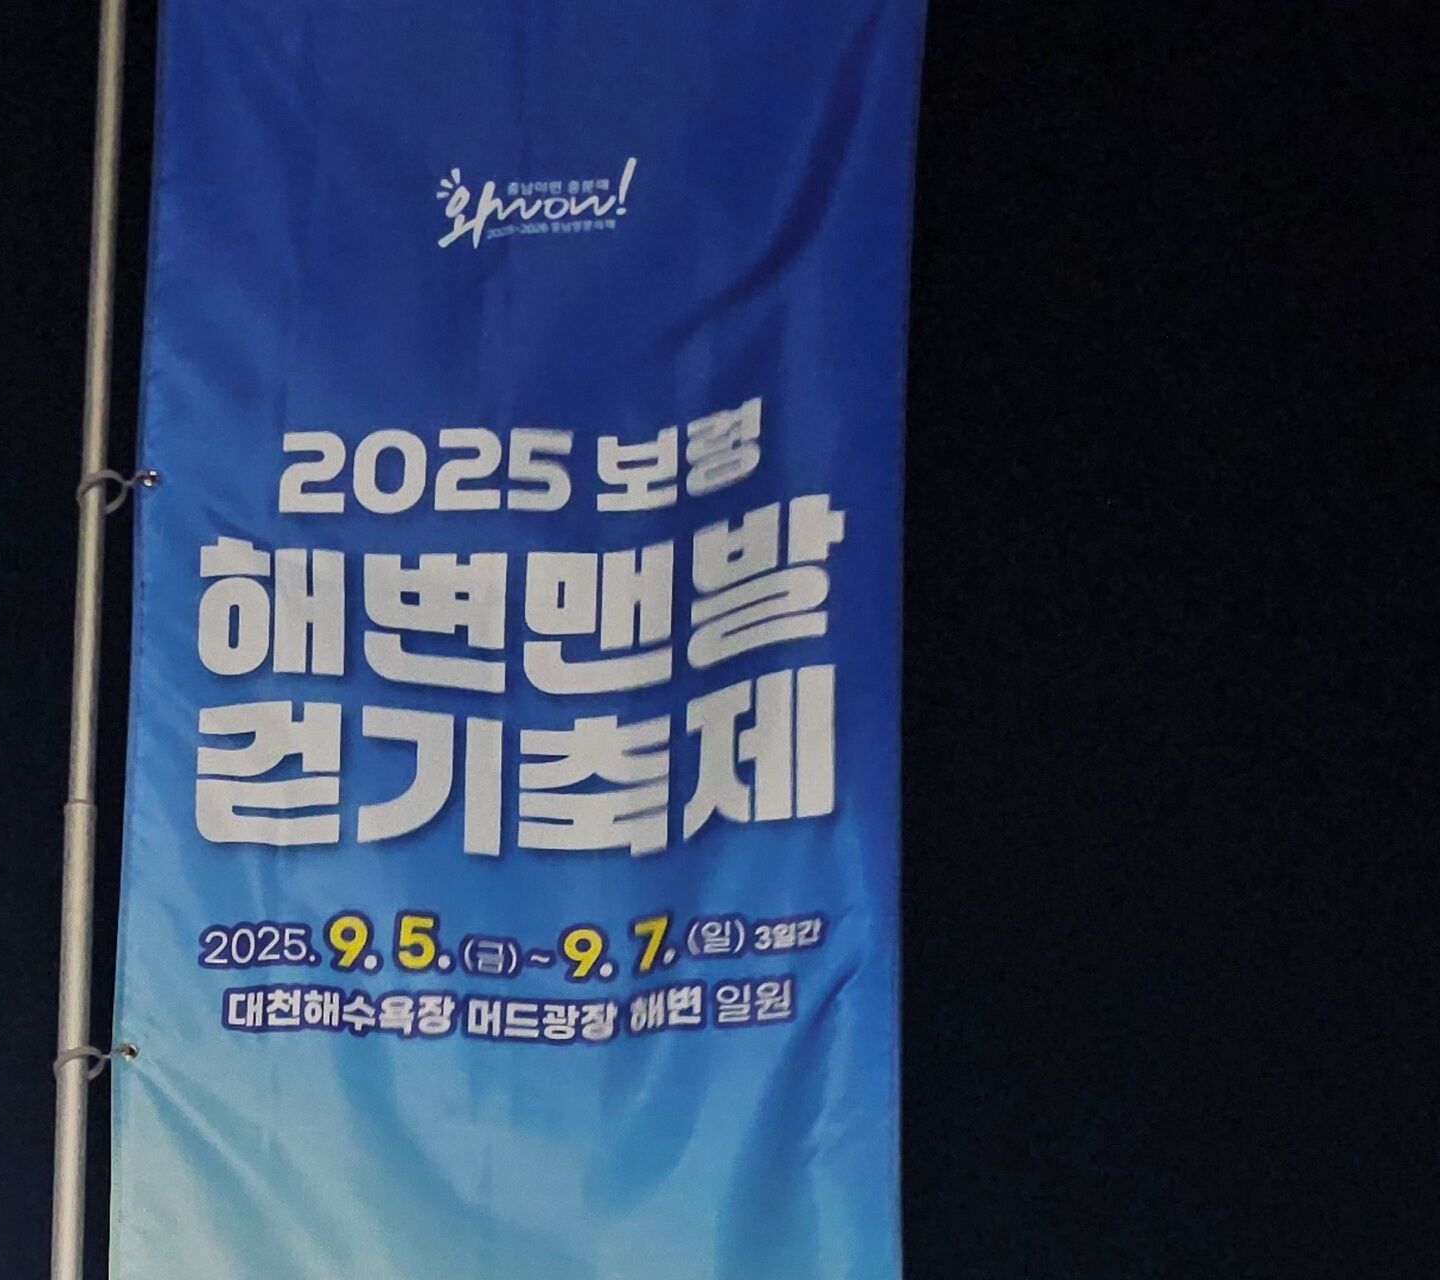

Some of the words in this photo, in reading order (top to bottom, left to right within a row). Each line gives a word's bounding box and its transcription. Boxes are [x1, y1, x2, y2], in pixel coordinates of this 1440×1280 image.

[278, 428, 573, 514] 2025
[596, 397, 762, 512] 보령
[197, 494, 845, 694] 해변맨발
[196, 664, 836, 857] 걷기축제
[203, 926, 317, 966] 2025.
[328, 915, 376, 970] 9.
[397, 915, 451, 970] 5.
[563, 928, 613, 977] 9.
[687, 920, 744, 957] (일)
[227, 989, 454, 1035] 대천해수욕장
[467, 1000, 616, 1040] 머드광장
[629, 988, 701, 1030] 해변
[716, 978, 791, 1021] 일원
